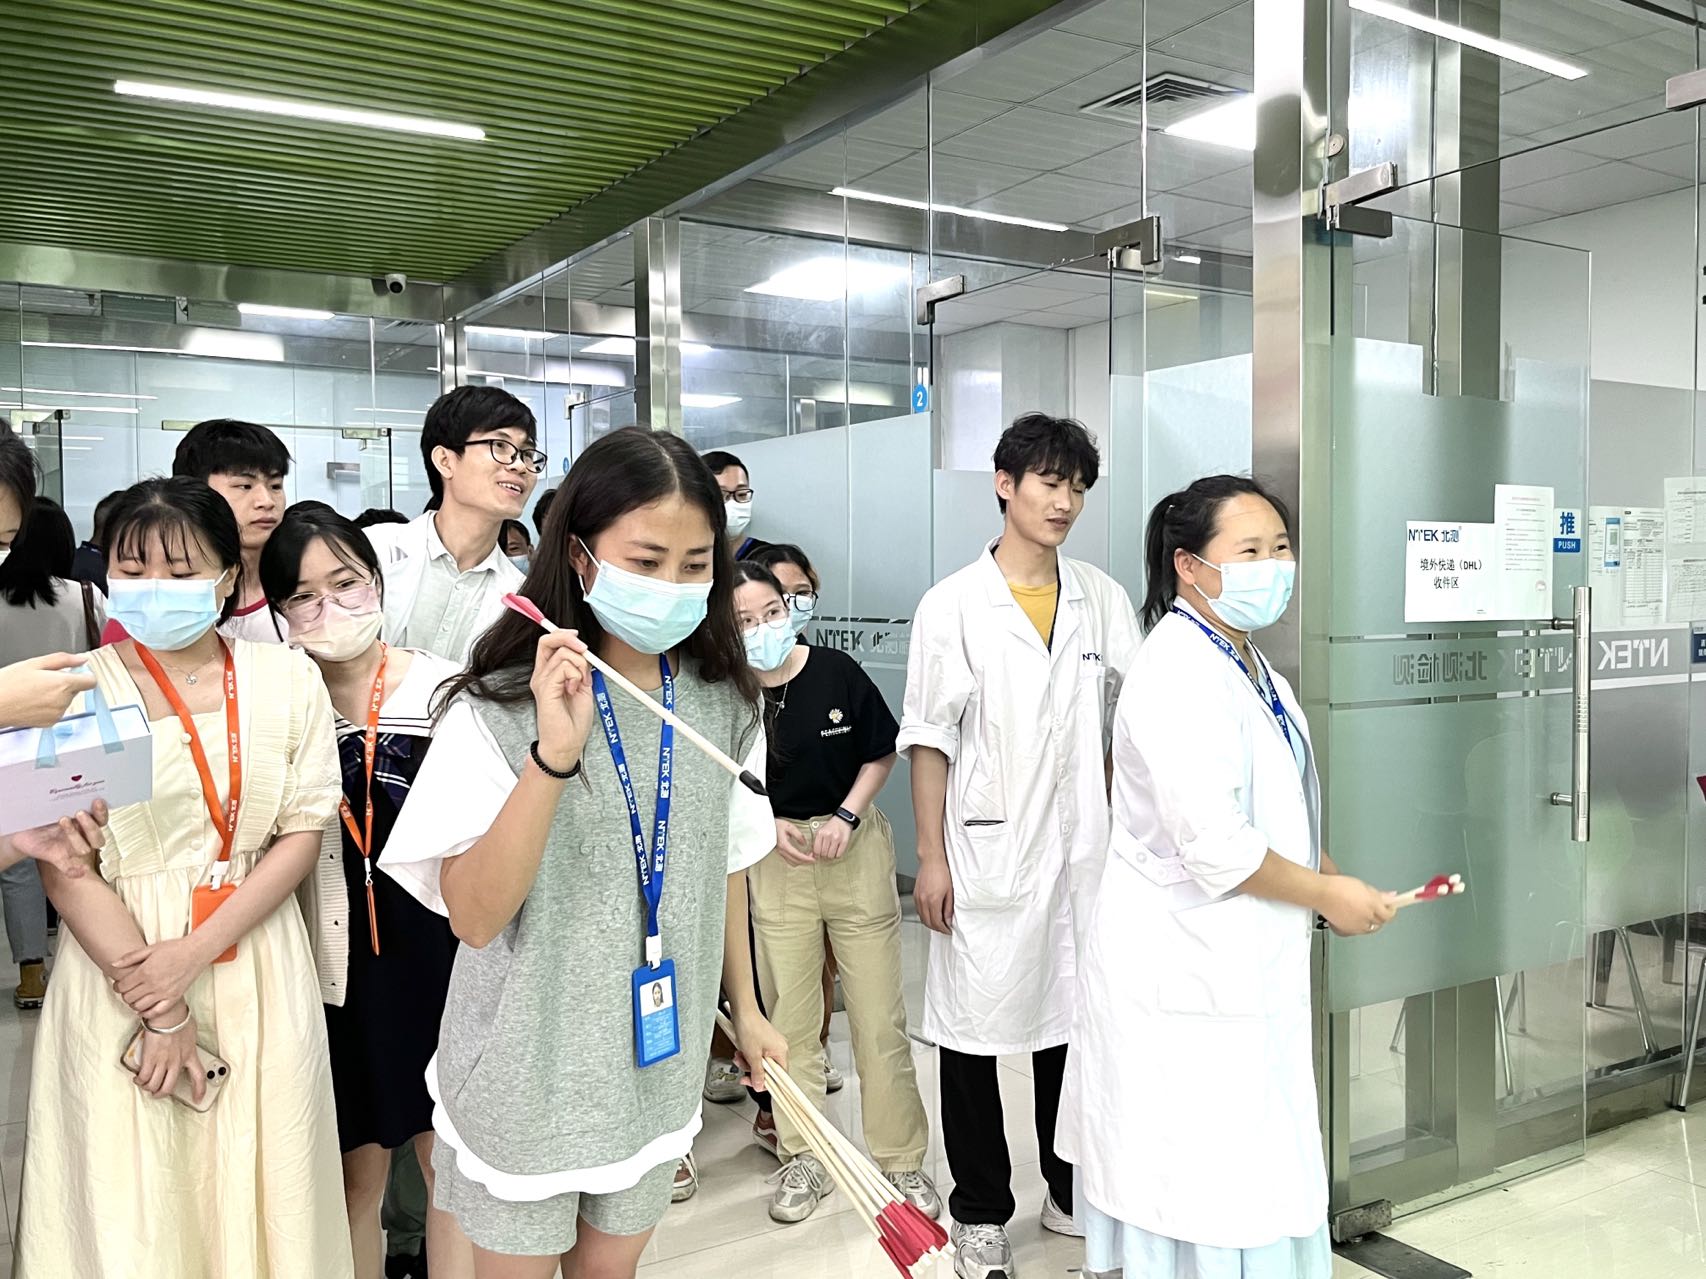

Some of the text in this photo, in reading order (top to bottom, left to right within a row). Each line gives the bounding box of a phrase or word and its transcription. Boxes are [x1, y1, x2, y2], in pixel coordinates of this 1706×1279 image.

[917, 391, 923, 407] 2
[1560, 511, 1575, 535] 推
[1558, 540, 1576, 549] PUSH
[1434, 576, 1460, 589] 收件区
[664, 675, 673, 705] NTEK
[602, 712, 618, 744] NTEK
[661, 747, 671, 778] NTEK
[656, 820, 666, 851] NTEK
